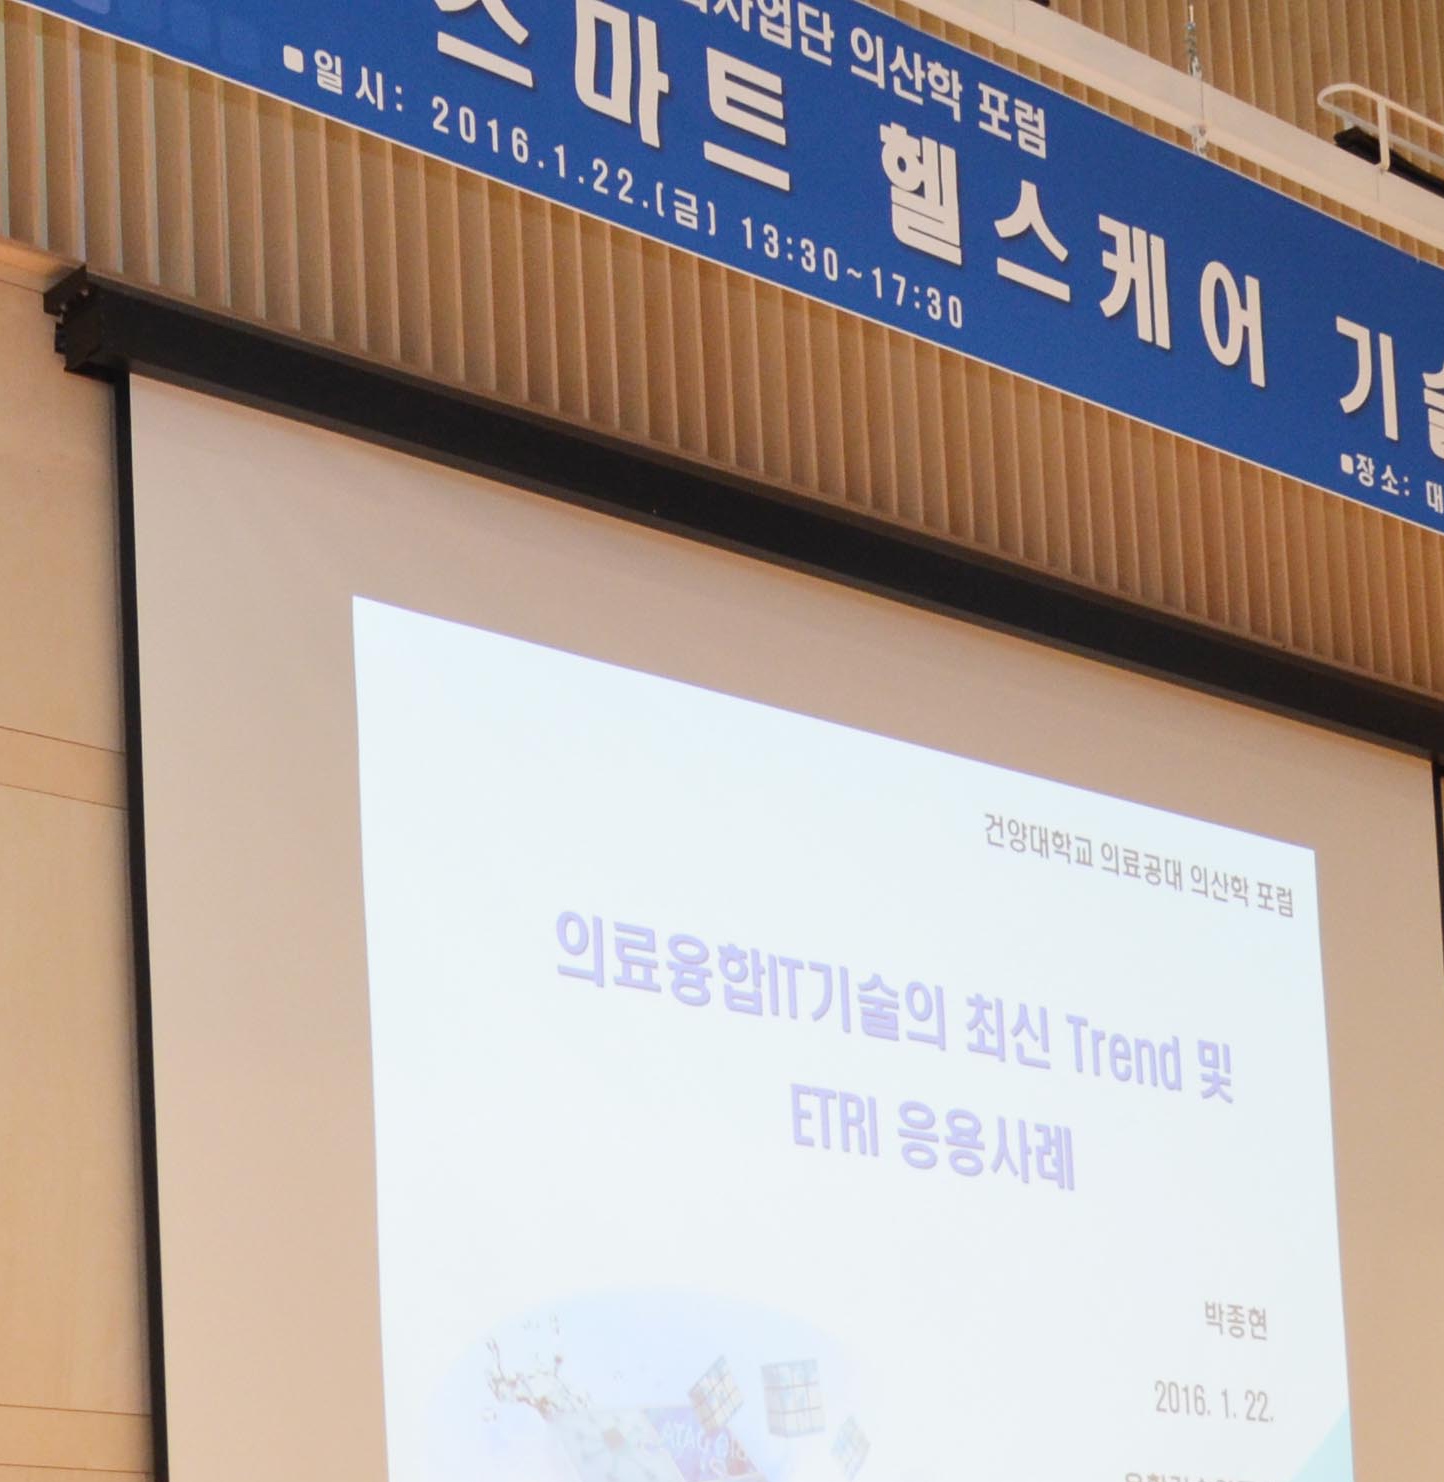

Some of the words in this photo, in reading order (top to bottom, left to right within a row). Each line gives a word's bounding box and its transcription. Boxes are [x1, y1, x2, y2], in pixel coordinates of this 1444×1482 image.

[683, 0, 835, 66] 사업단
[850, 27, 963, 122] 의산학
[978, 82, 1047, 159] 포럼
[432, 96, 716, 236] 2016.1.22.(금)
[742, 217, 963, 329] 13:30~17:30
[433, 0, 790, 191] 스마트
[879, 121, 1266, 388] 헬스케어
[984, 813, 1093, 868] 건양대학교
[1100, 842, 1183, 891] 의료공대
[1190, 864, 1249, 907] 의산학
[1256, 881, 1294, 919] 포럼
[556, 910, 947, 1051] 의료융합IT기술의
[965, 993, 1052, 1071] 최신
[1065, 1013, 1183, 1092] Trend
[1197, 1038, 1234, 1104] 및
[790, 1083, 880, 1158] ETRI
[897, 1101, 1076, 1191] 응용사례
[1204, 1301, 1267, 1341] 박종현
[1154, 1380, 1211, 1417] 2016.
